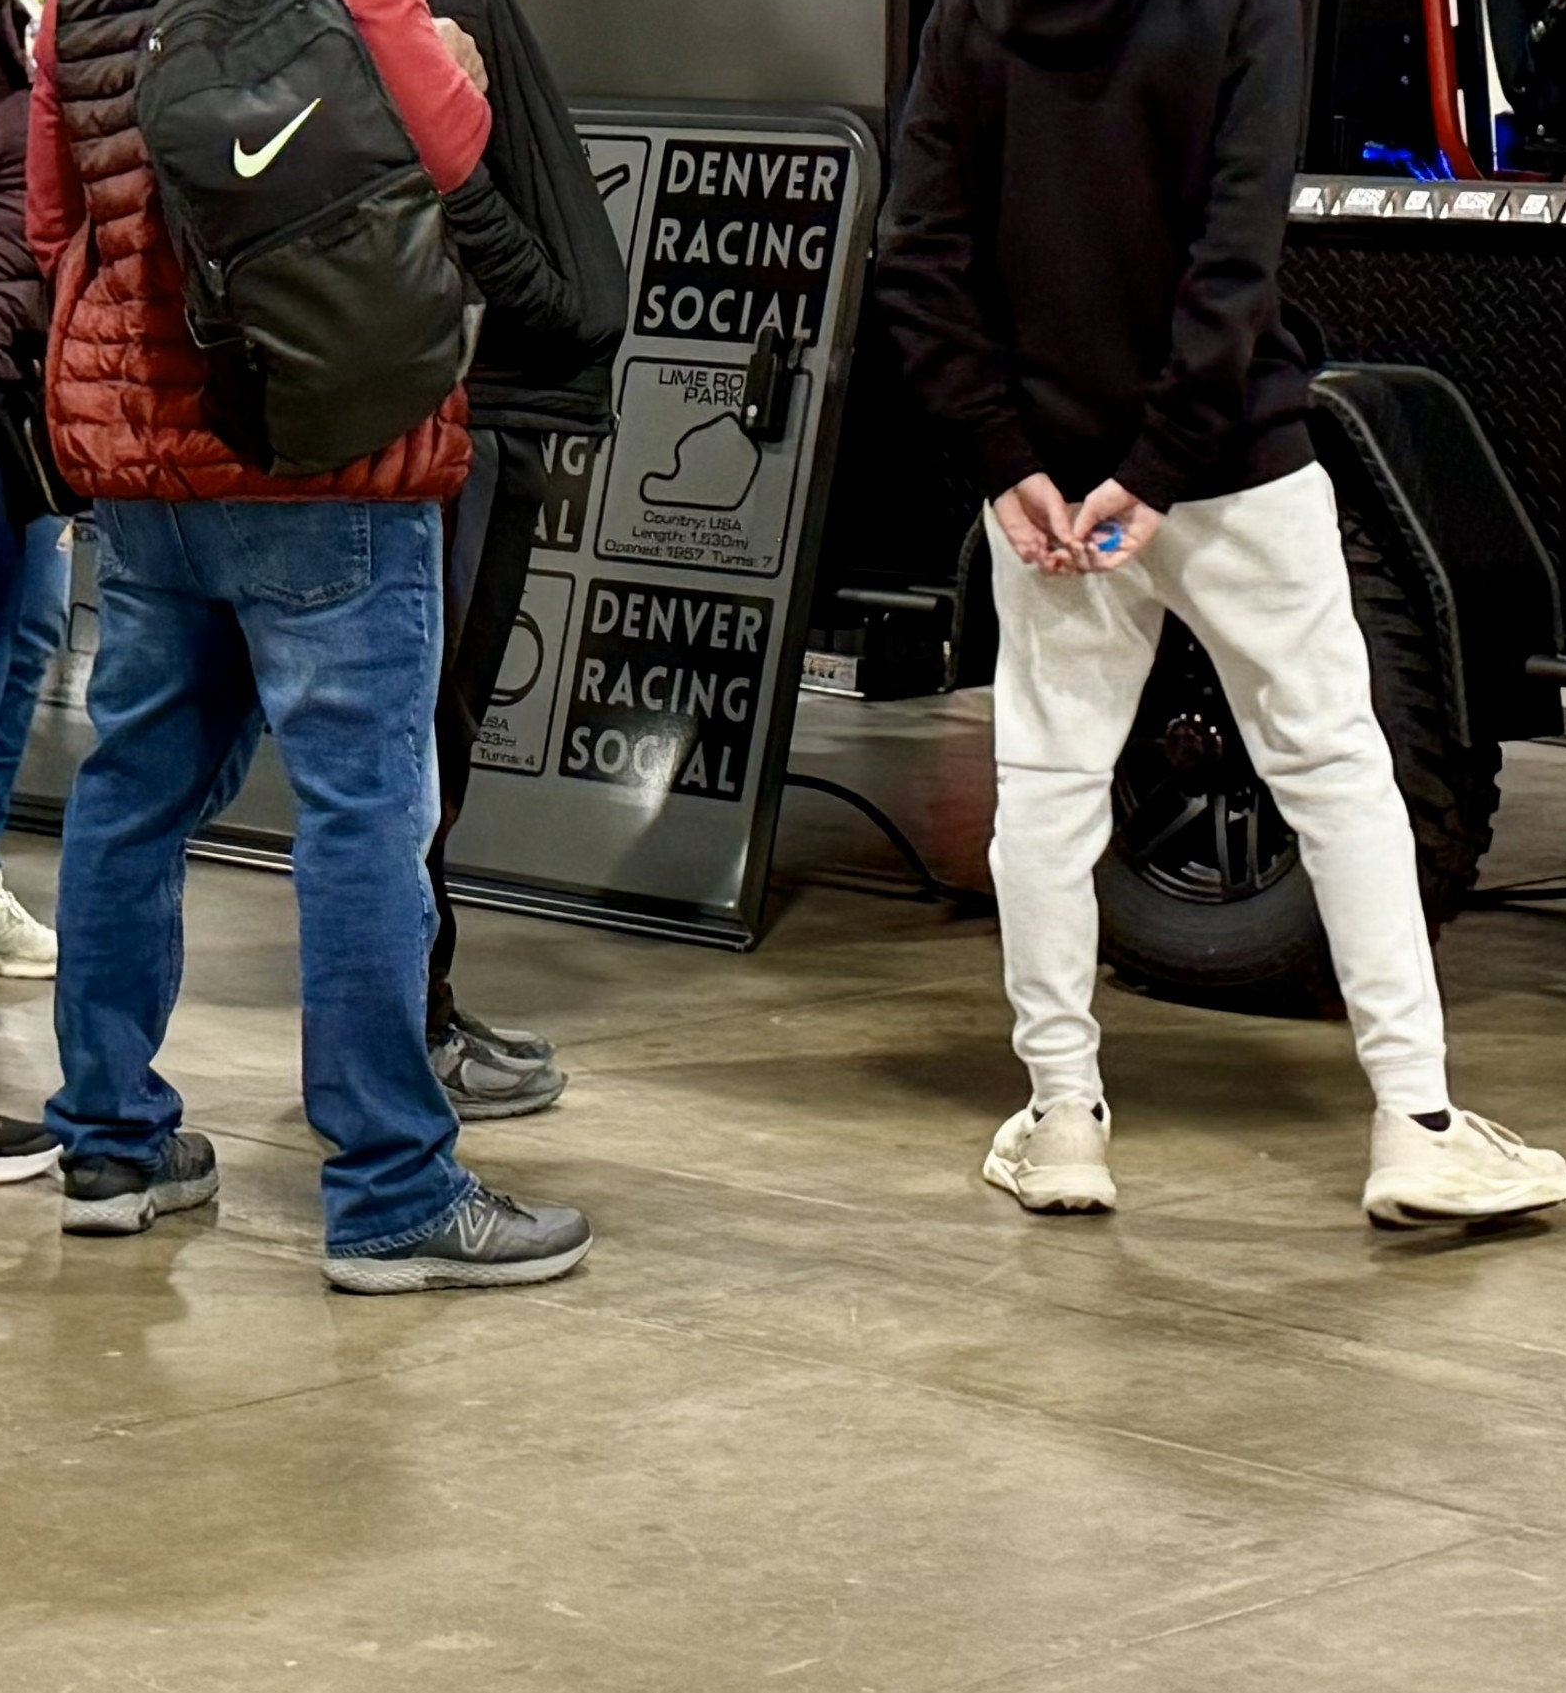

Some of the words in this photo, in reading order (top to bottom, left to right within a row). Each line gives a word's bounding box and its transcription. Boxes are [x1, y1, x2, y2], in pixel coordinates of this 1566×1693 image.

[666, 150, 840, 202] DENVER
[654, 217, 827, 270] RACING
[642, 285, 812, 340] SOCIAL
[659, 367, 708, 387] LIME
[684, 387, 742, 408] PARK
[632, 526, 685, 543] Length:
[643, 510, 705, 530] Country:
[709, 517, 742, 531] USA
[604, 539, 661, 557] Opened:
[762, 556, 773, 569] 7
[590, 591, 763, 653] DENVER
[578, 658, 751, 723] RACING
[566, 725, 736, 793] SOCIAL
